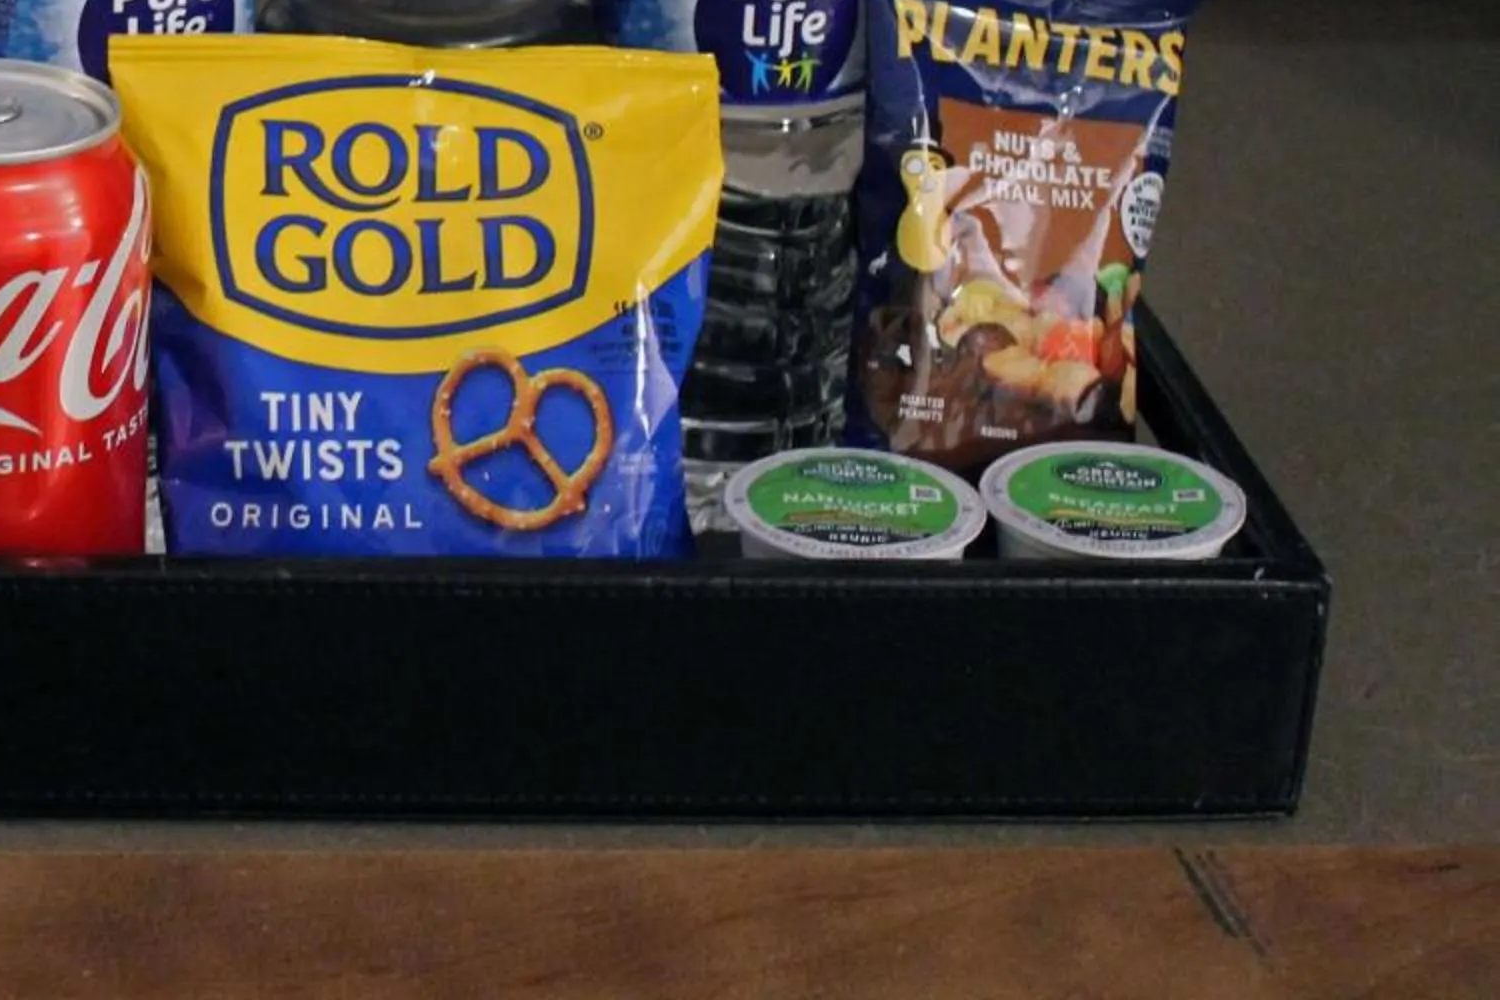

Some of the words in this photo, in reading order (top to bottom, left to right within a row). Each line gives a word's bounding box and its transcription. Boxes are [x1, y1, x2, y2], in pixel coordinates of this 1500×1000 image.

[742, 1, 827, 59] Life
[259, 119, 553, 213] ROLD
[994, 129, 1056, 161] NUTS
[1062, 140, 1082, 164] &
[969, 149, 1112, 188] CHOCOLATE
[984, 176, 1045, 206] TRAIL
[1050, 186, 1096, 210] MIX
[254, 213, 557, 297] GOLD
[102, 397, 150, 452] TAST
[259, 390, 364, 433] TINY
[223, 438, 405, 482] TWISTS
[210, 502, 424, 530] ORIGINAL
[783, 492, 923, 516] NANTUCKET
